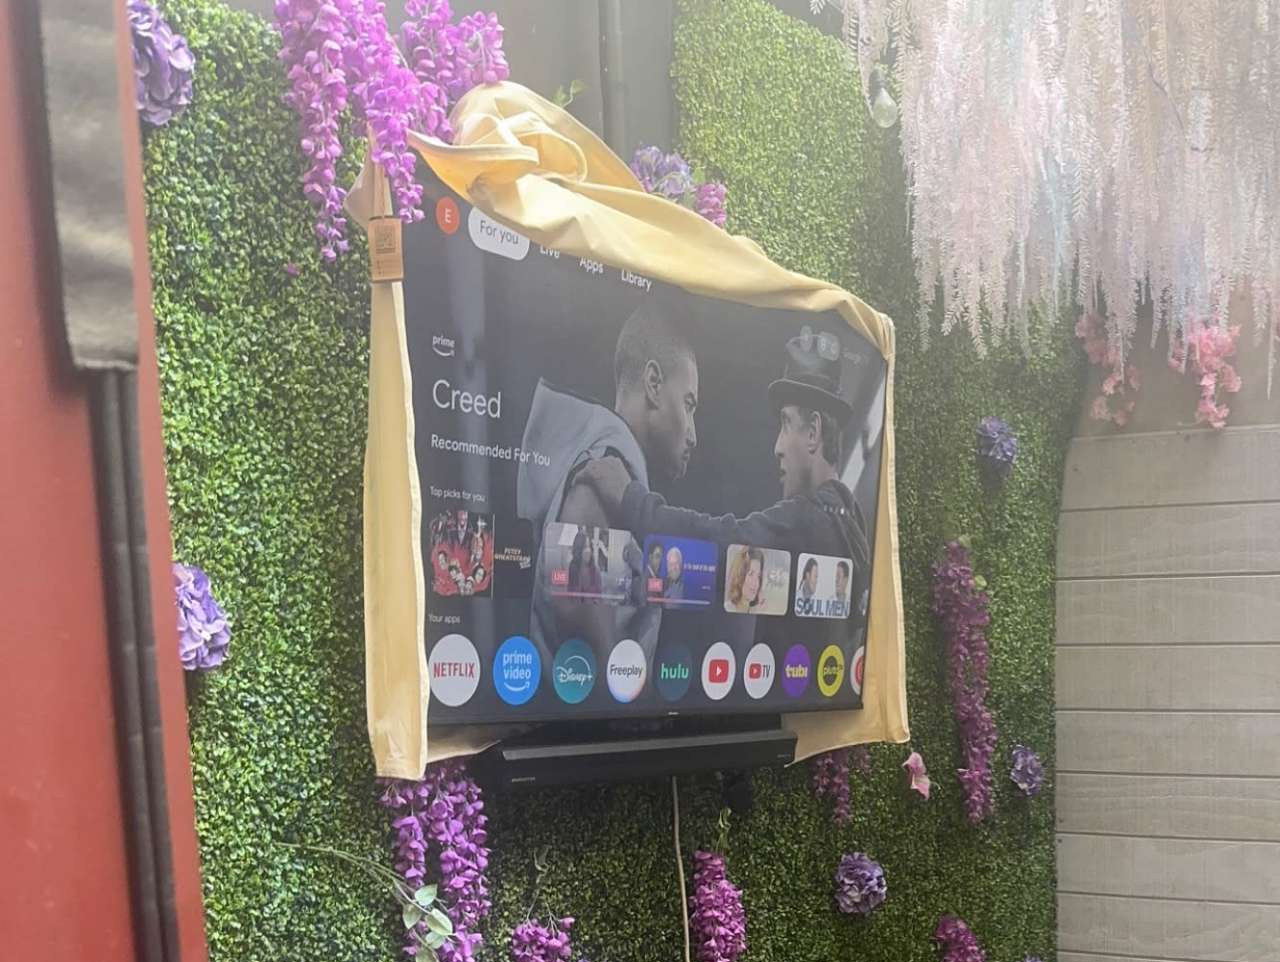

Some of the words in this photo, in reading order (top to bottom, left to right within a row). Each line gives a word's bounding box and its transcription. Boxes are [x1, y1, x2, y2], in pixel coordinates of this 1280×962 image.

[444, 207, 452, 224] E
[479, 219, 498, 238] For
[499, 227, 520, 246] you
[579, 256, 604, 275] Apps
[620, 268, 653, 293] Library
[432, 335, 455, 348] prime
[432, 379, 502, 418] Creed
[431, 433, 512, 460] Recommended
[513, 447, 530, 463] For
[533, 451, 551, 466] You
[443, 488, 461, 500] picks
[462, 489, 472, 500] for
[472, 492, 486, 504] you
[796, 598, 824, 616] SOUL
[826, 600, 850, 617] MEN
[428, 613, 443, 623] Your
[444, 615, 460, 625] apps
[502, 652, 533, 666] prime
[433, 661, 475, 679] NETFLIX
[503, 666, 532, 680] video
[556, 662, 593, 686] Disney+
[609, 664, 643, 680] Freeplay
[660, 663, 689, 679] hulu
[762, 664, 771, 679] TV
